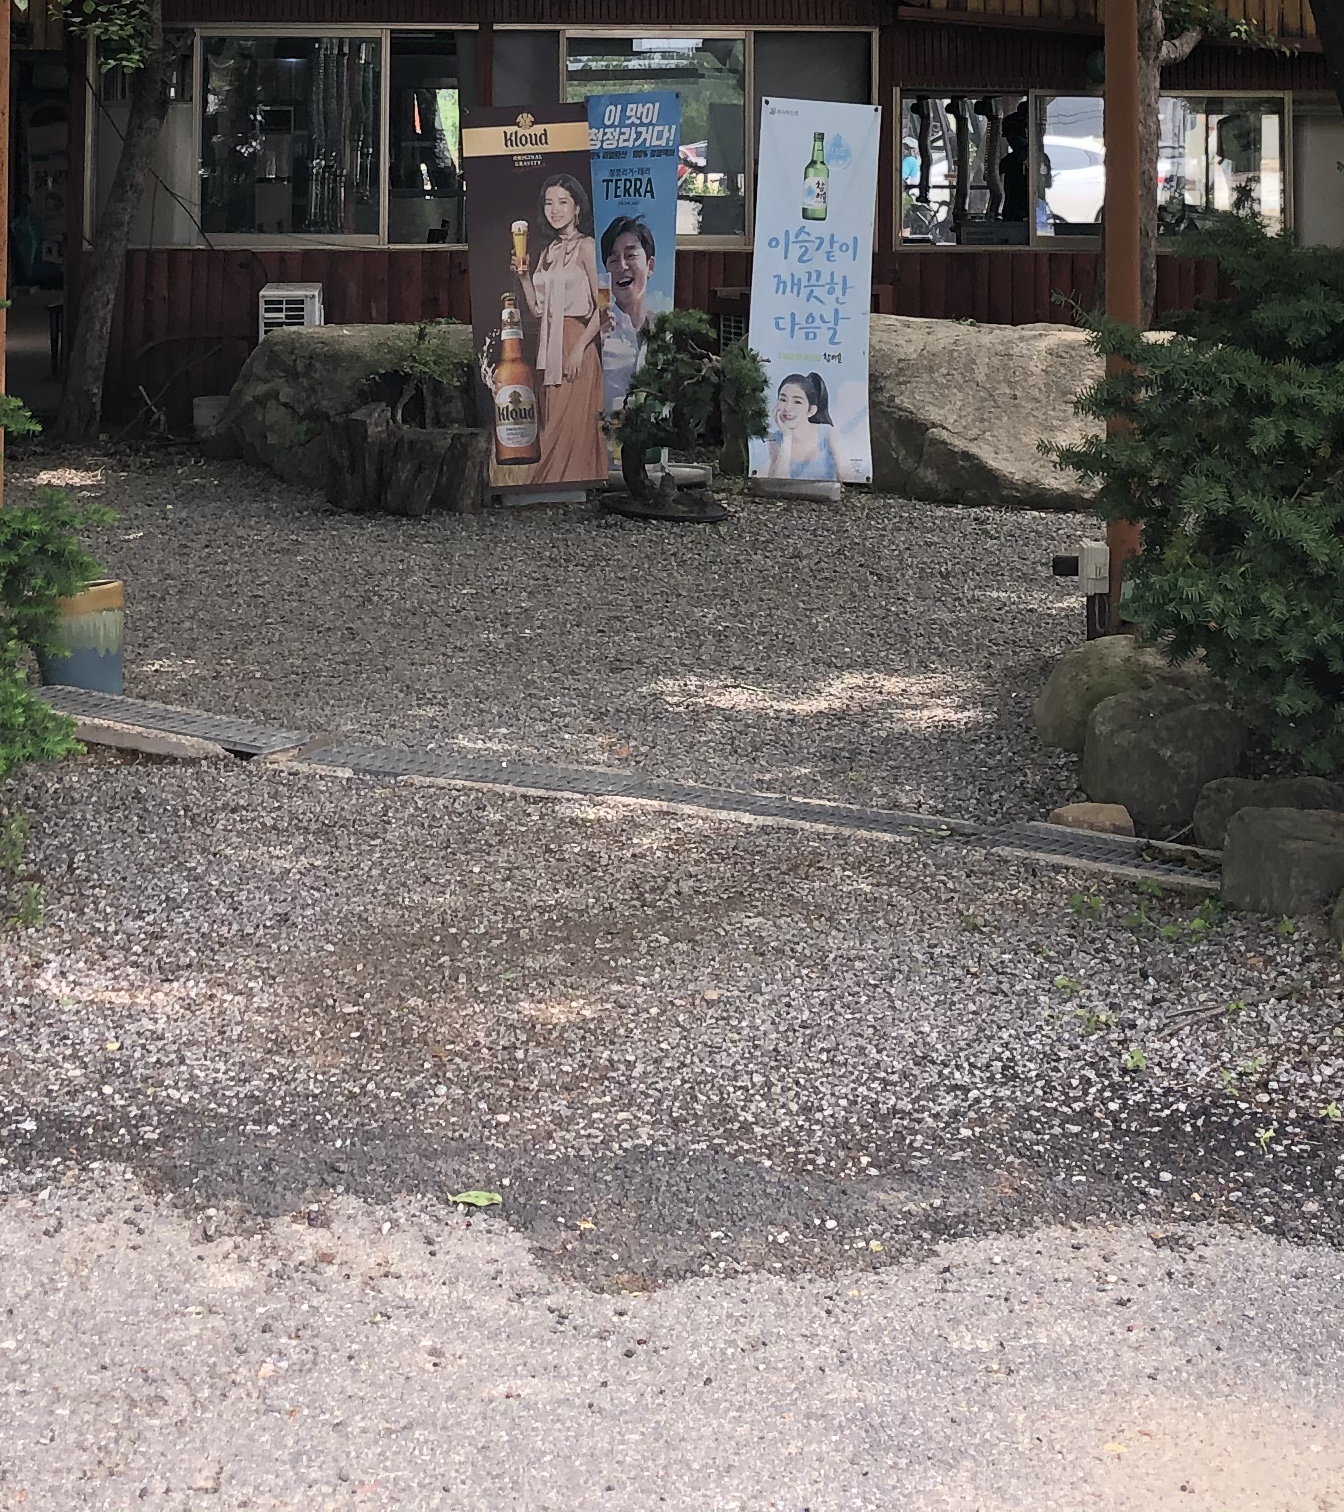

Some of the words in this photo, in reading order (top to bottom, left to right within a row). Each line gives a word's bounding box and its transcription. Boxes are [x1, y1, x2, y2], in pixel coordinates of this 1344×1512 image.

[603, 104, 622, 126] 이
[624, 102, 660, 125] 맛이
[588, 124, 676, 150] 청정라거다!
[601, 177, 655, 201] TERRA
[767, 225, 858, 264] 이슬같이
[772, 269, 855, 305] 깨끗한
[773, 307, 850, 346] 다음날
